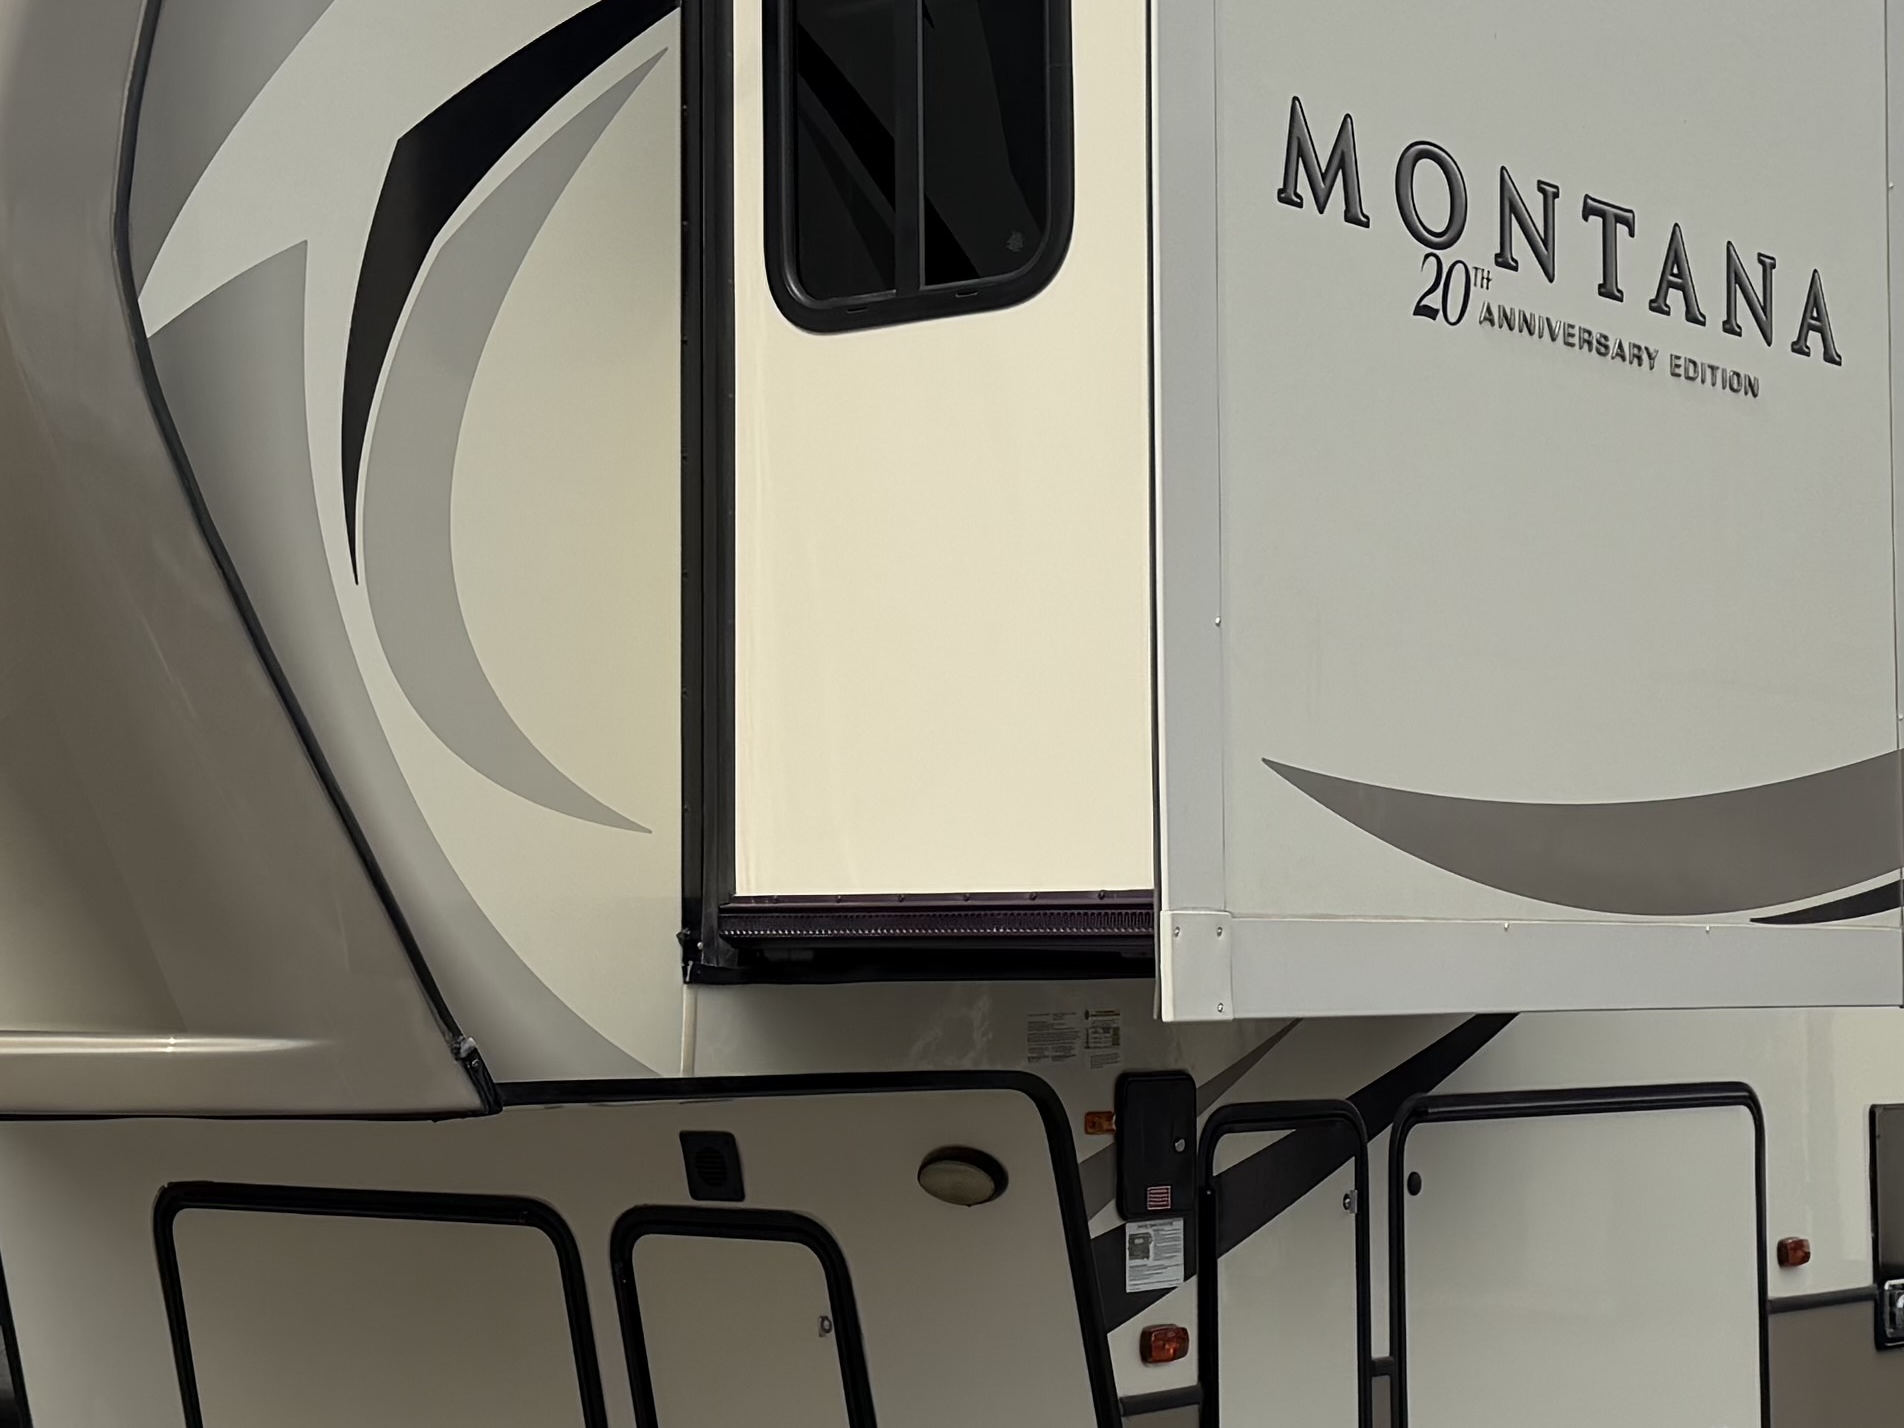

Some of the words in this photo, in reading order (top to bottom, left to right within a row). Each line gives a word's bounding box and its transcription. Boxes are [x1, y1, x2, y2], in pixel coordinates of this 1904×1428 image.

[1276, 95, 1842, 367] MONTANA
[1479, 301, 1660, 371] ANNIVERSARY
[1669, 353, 1760, 399] EDITION
